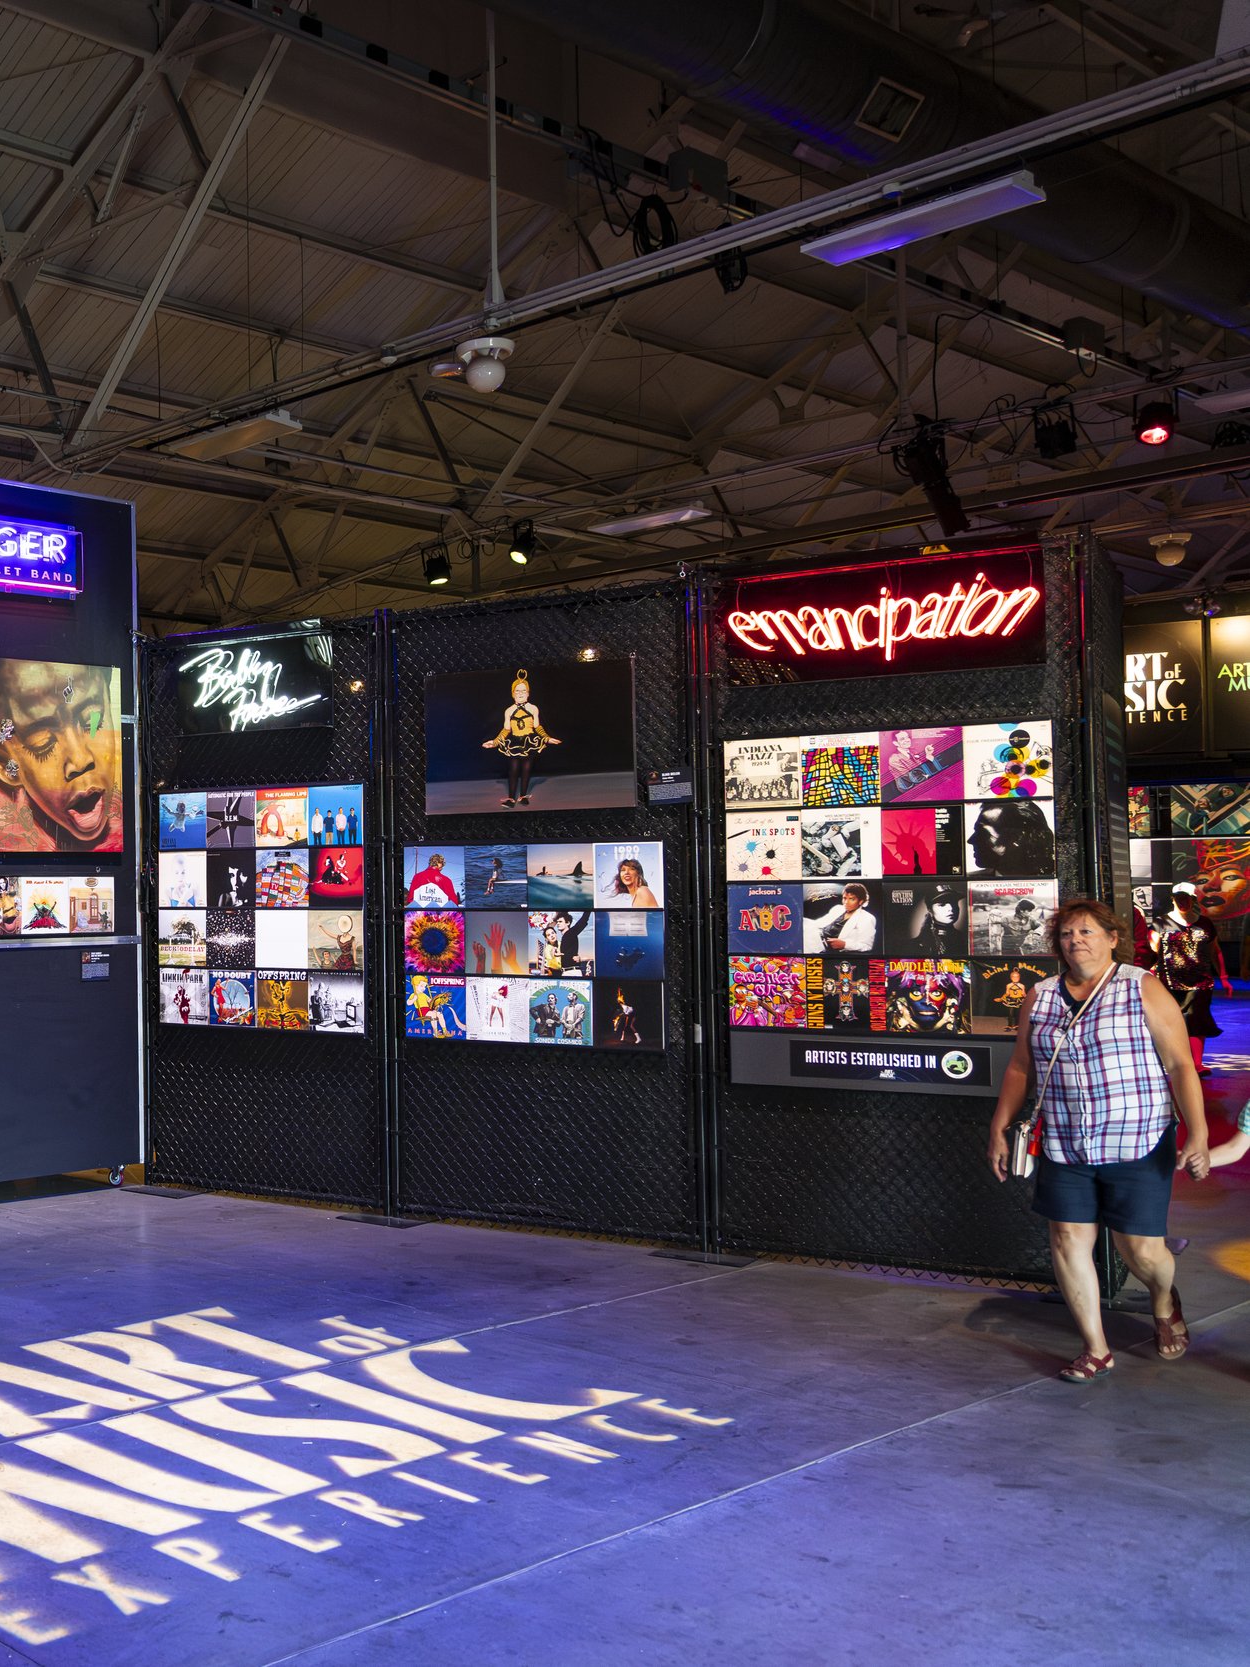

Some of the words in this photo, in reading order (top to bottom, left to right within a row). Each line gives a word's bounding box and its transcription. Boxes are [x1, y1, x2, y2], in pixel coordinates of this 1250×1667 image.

[31, 569, 73, 583] BAND
[728, 572, 1040, 661] emancipation
[1125, 652, 1168, 682] RT
[1124, 678, 1187, 712] SIC
[1128, 709, 1188, 724] IENCE
[738, 745, 782, 755] INDIANA
[747, 752, 773, 762] JAZZ
[752, 828, 767, 837] INK
[769, 827, 796, 836] SPOTS
[614, 845, 640, 860] 1989
[749, 888, 776, 897] jackson
[994, 888, 1034, 896] SCARECROW
[739, 904, 792, 932] ABC
[889, 961, 915, 972] DAVID
[917, 961, 935, 972] LEE
[185, 972, 204, 983] PARK
[212, 971, 223, 979] NO
[223, 971, 252, 980] DOUBT
[257, 970, 307, 981] OFFSPRING
[806, 957, 824, 990] ROSES
[433, 977, 464, 986] OFFSPRING
[806, 1003, 825, 1029] GUNS
[407, 1028, 463, 1036] AMERCNA
[805, 1050, 848, 1065] ARTISTS
[850, 1051, 922, 1069] ESTABLISHED
[924, 1055, 937, 1069] IN
